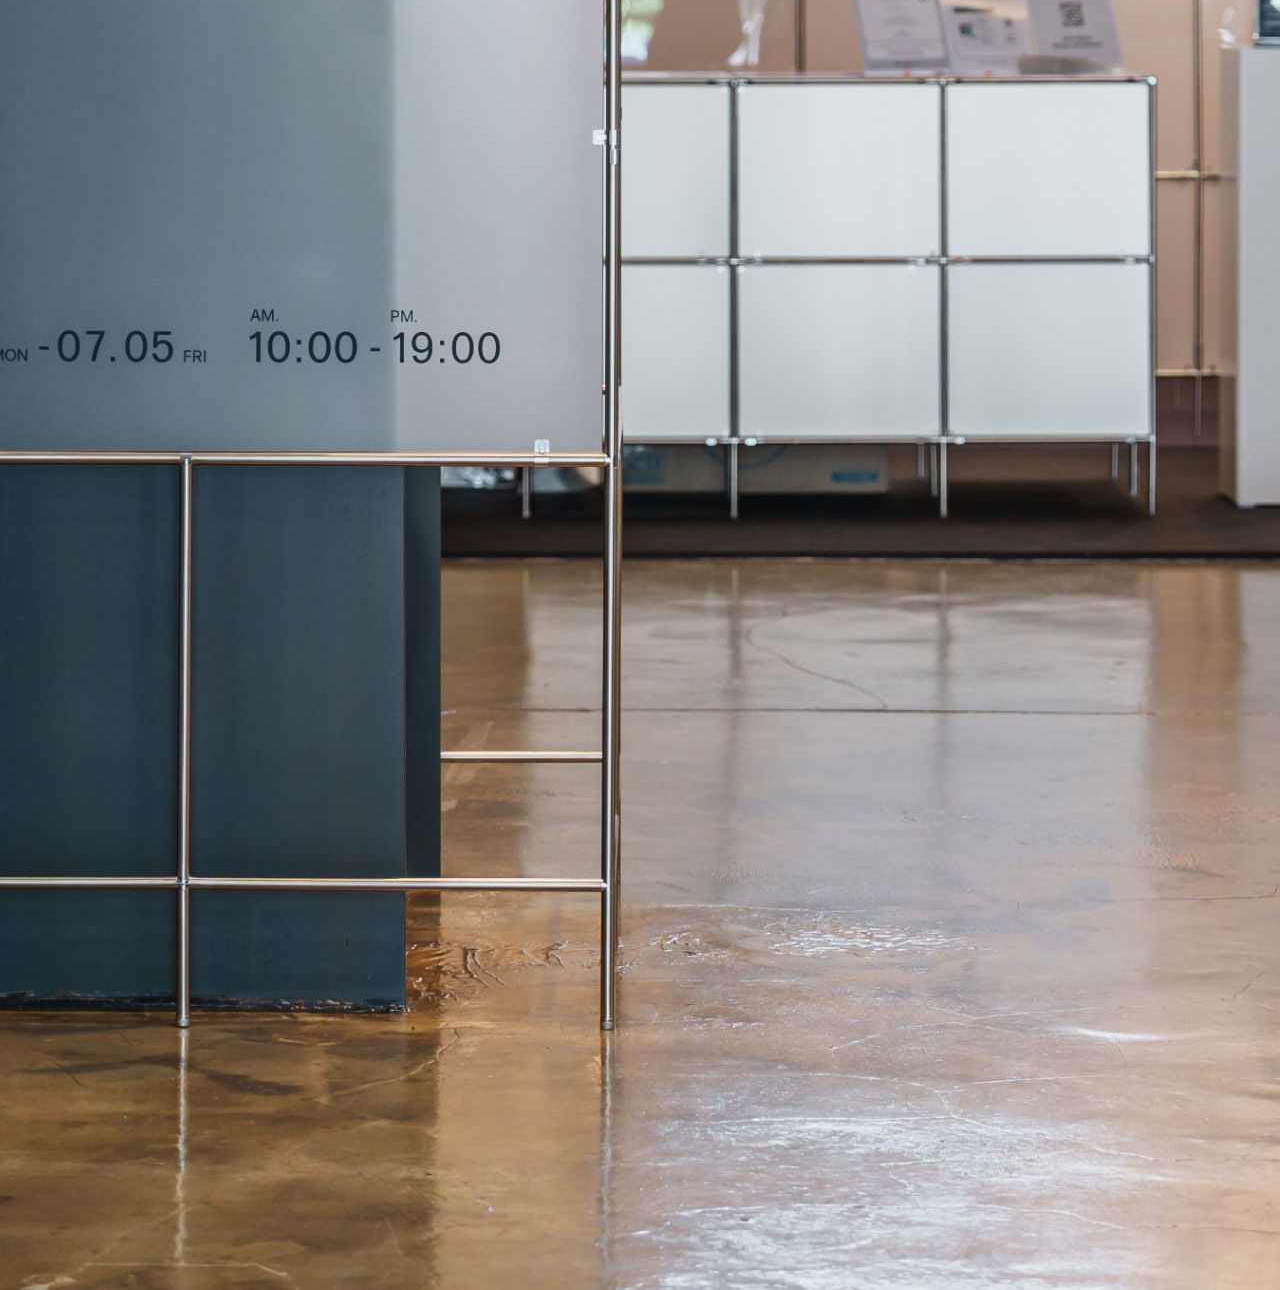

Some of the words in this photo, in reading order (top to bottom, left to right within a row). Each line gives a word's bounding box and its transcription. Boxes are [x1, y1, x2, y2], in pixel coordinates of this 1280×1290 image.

[249, 308, 280, 322] AM.
[390, 310, 418, 323] PM.
[249, 331, 358, 363] 10:00
[393, 331, 502, 364] 19:00
[182, 349, 208, 363] FRI
